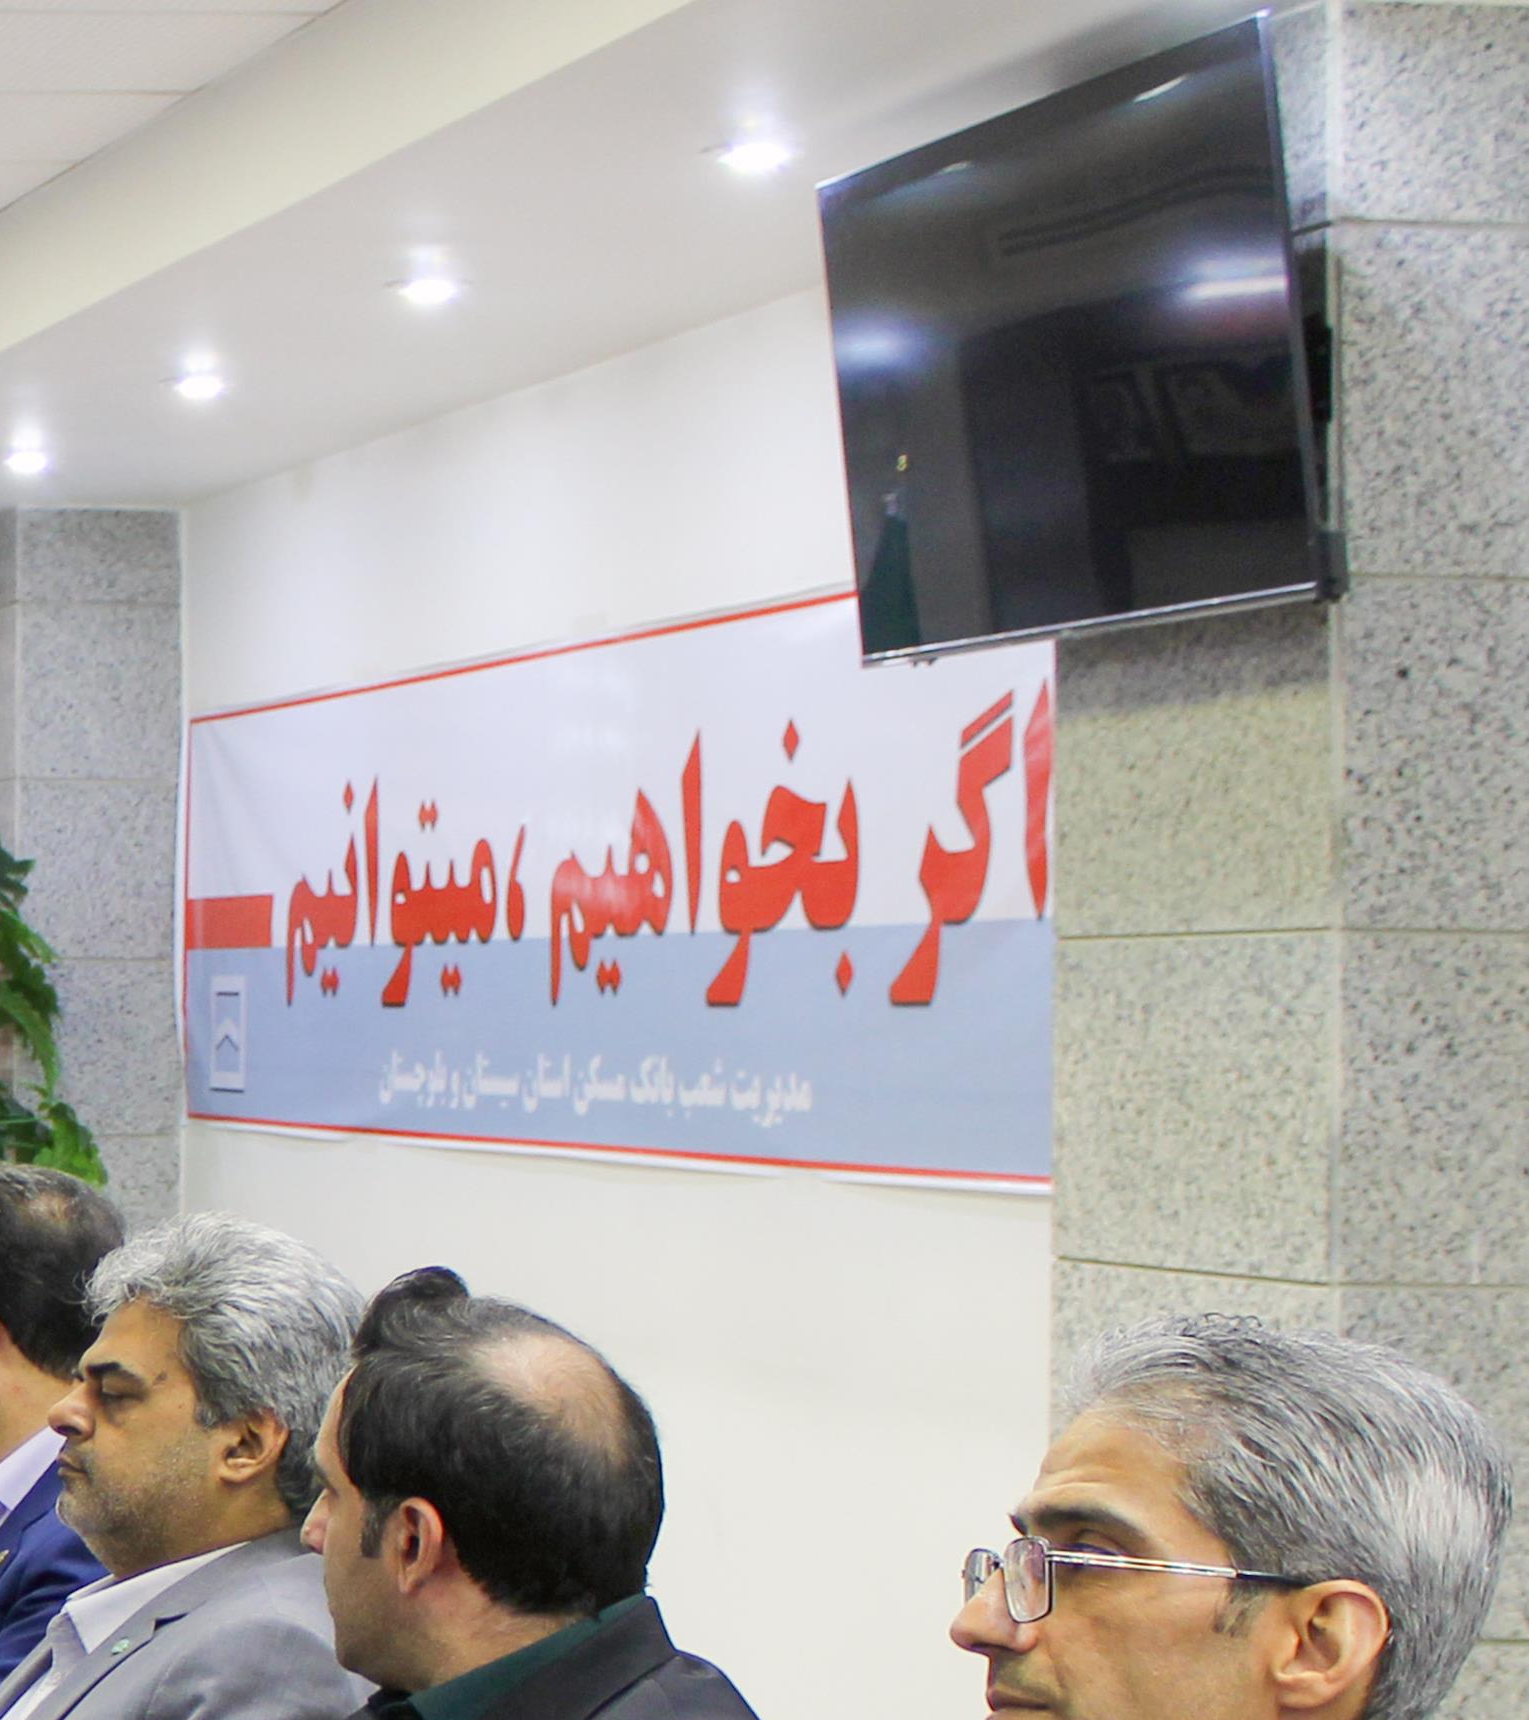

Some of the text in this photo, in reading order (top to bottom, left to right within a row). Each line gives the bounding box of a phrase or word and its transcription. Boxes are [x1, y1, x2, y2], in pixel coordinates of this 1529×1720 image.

[889, 678, 1051, 1007] اگر
[379, 1049, 448, 1108] بلوچستان
[462, 1050, 521, 1109] سیستان
[522, 1051, 571, 1113] استان
[573, 1054, 626, 1116] مسکن
[629, 1054, 675, 1118] بانک
[678, 1056, 728, 1119] شعب
[731, 1069, 812, 1128] مدیریت
